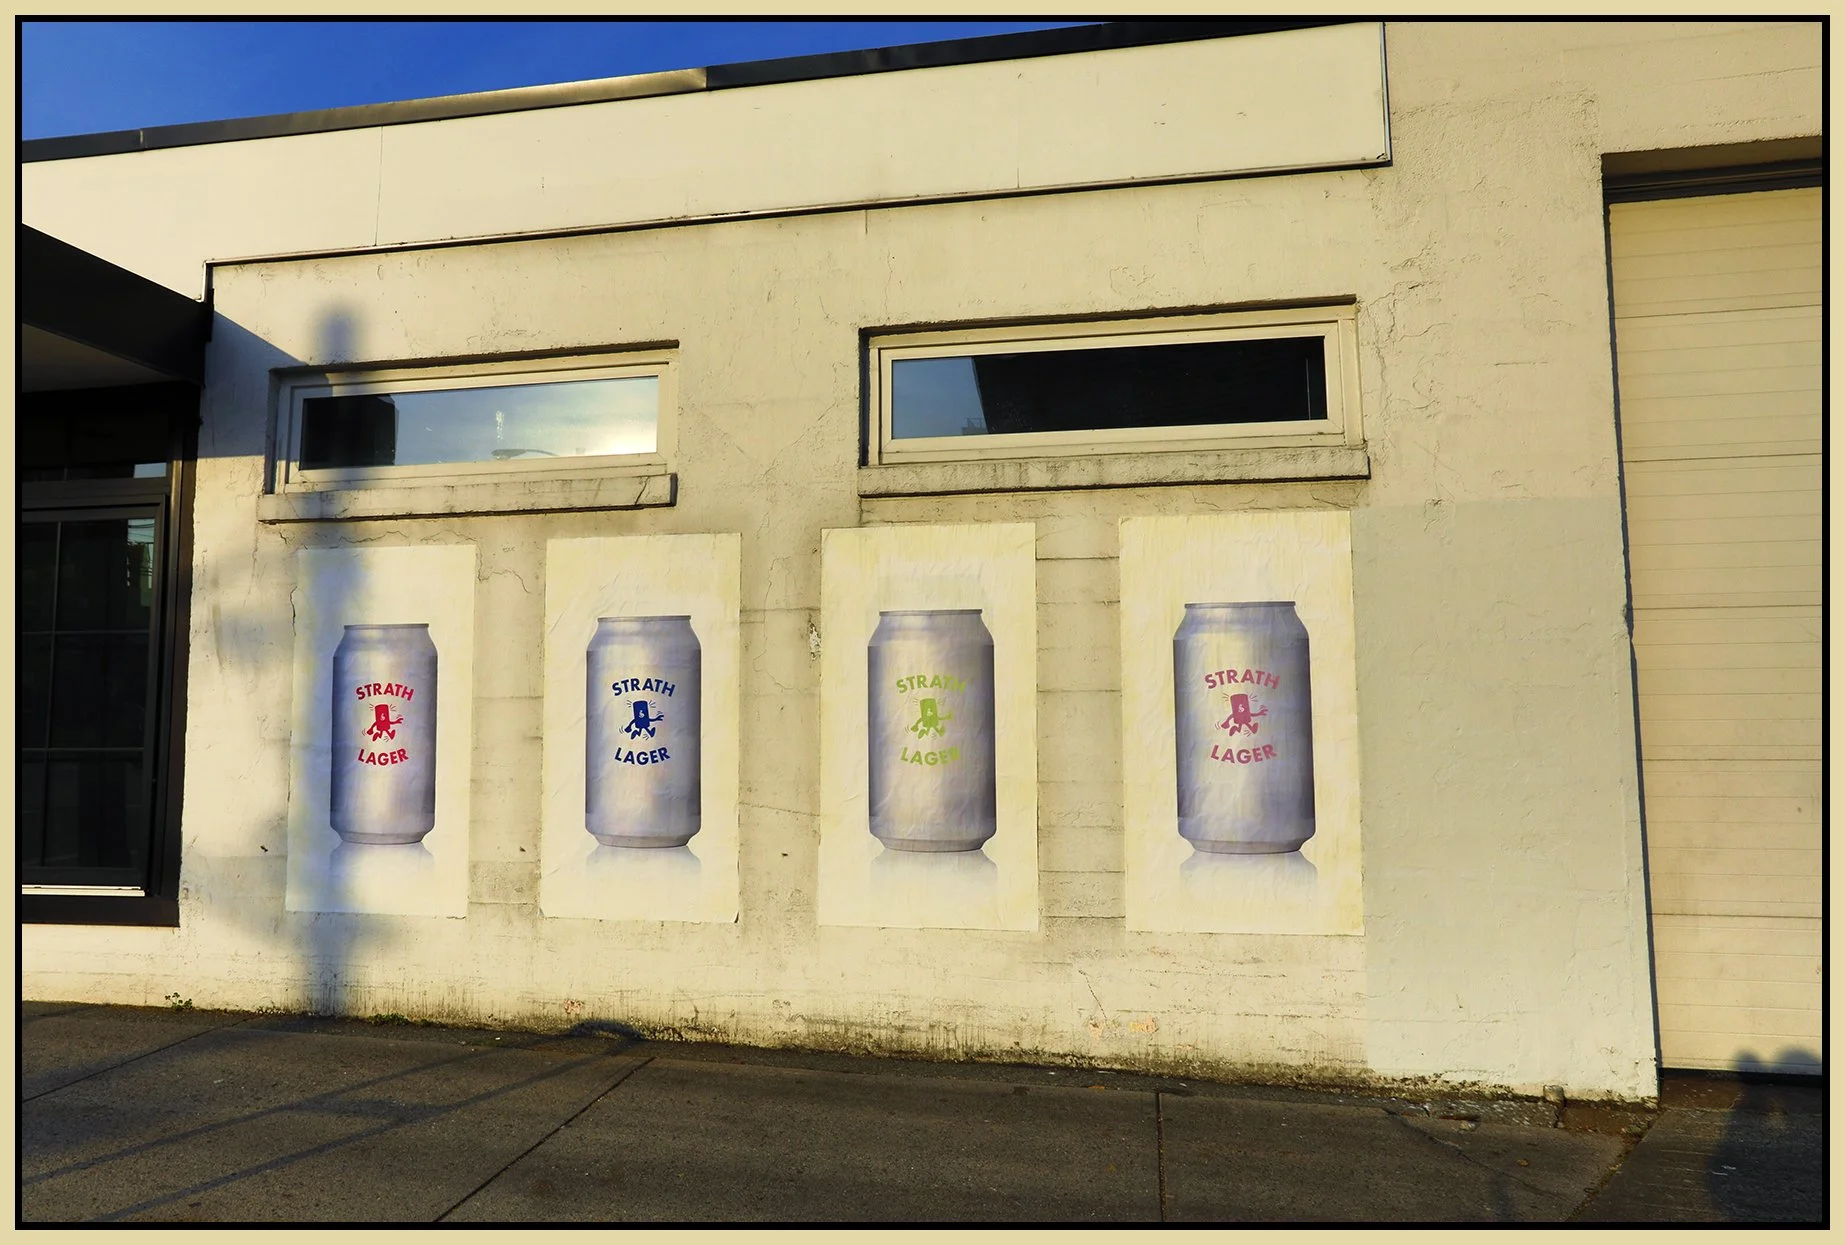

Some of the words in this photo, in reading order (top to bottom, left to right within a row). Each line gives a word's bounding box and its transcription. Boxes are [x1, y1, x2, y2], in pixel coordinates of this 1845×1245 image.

[612, 677, 675, 697] STRATH
[896, 674, 967, 694] STRATH
[1204, 669, 1280, 689] STRATH
[355, 682, 414, 701] STRATH
[357, 748, 409, 766] LAGER
[614, 746, 671, 765] LAGER
[1210, 744, 1277, 764] LAGER
